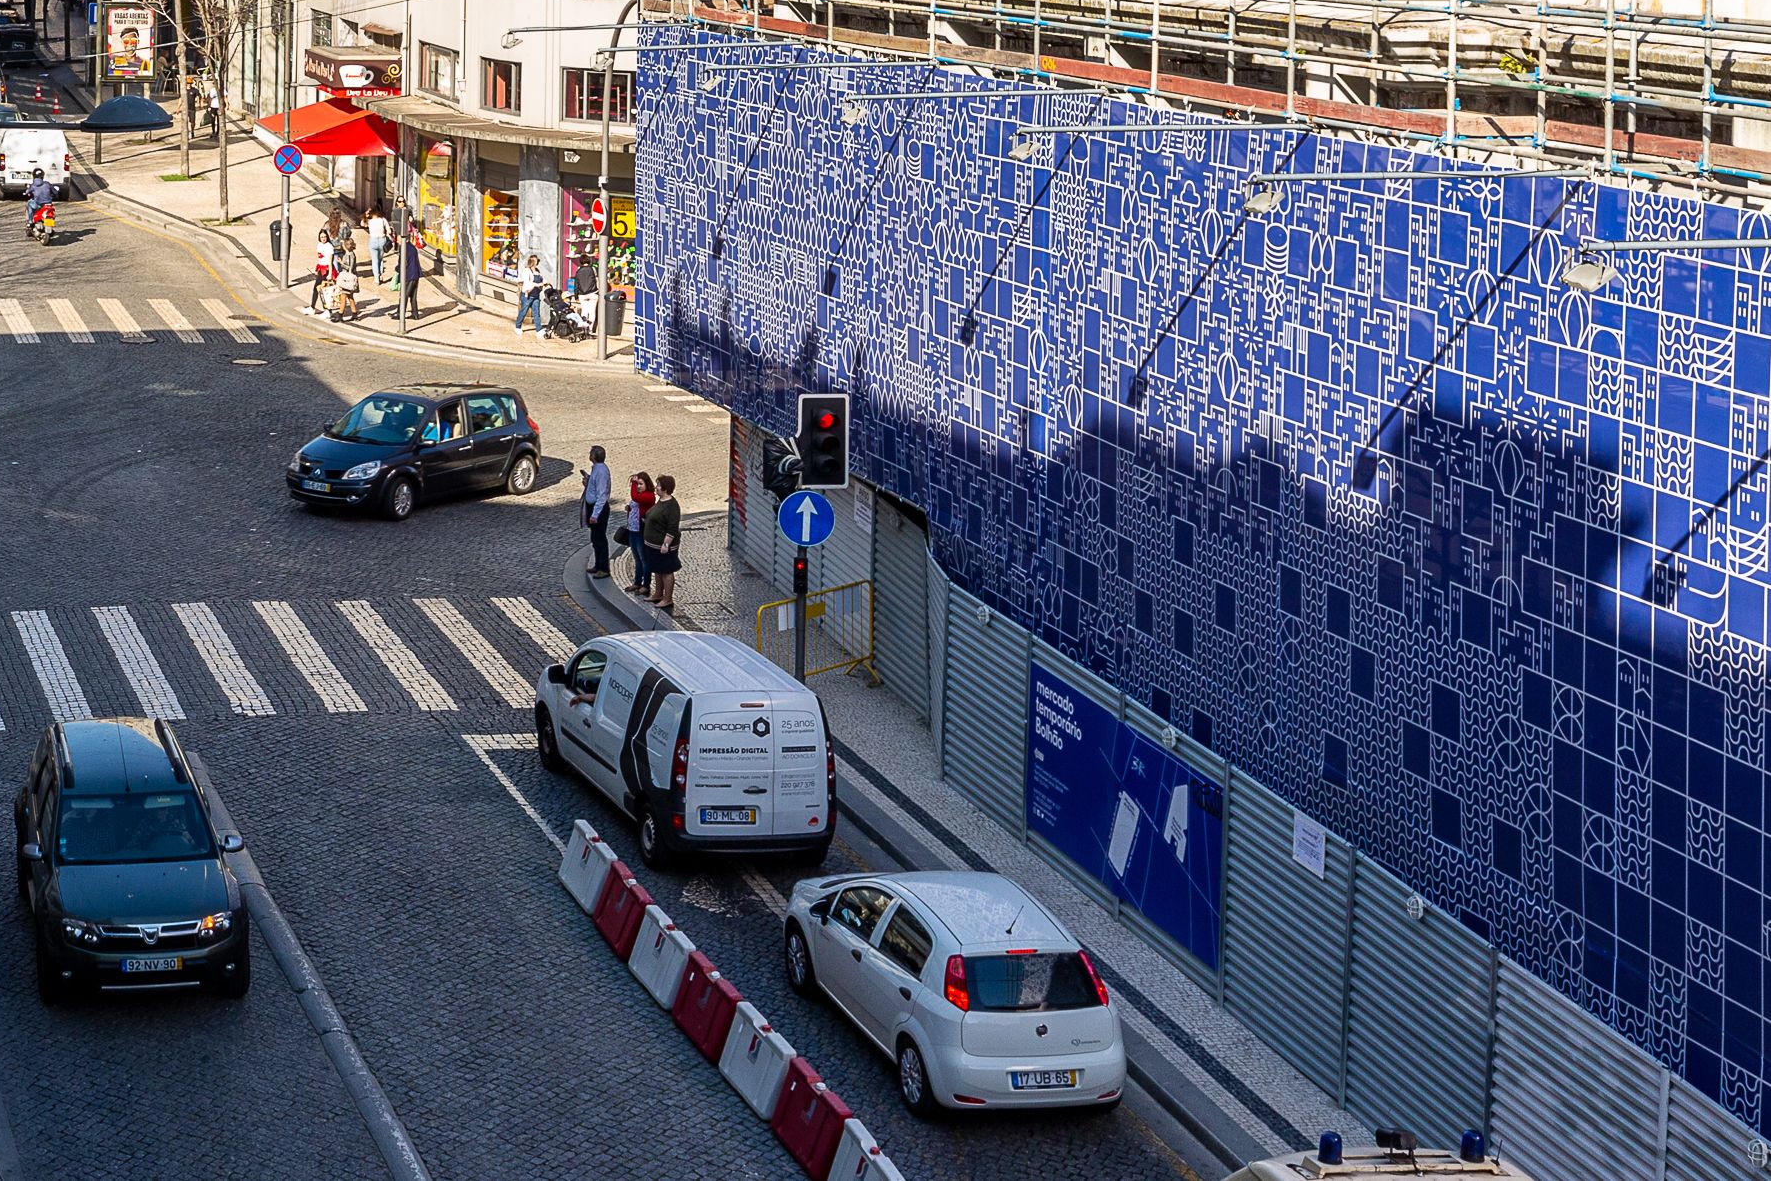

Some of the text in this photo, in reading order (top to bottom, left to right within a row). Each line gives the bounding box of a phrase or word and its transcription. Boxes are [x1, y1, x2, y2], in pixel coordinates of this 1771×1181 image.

[614, 212, 628, 236] 5
[1036, 681, 1074, 715] mercado
[699, 723, 751, 731] NORCOPIA
[781, 719, 815, 729] 25 anos
[1036, 697, 1082, 741] temporário
[1035, 716, 1063, 750] Bolhão
[699, 746, 740, 754] IMPRESSÃO
